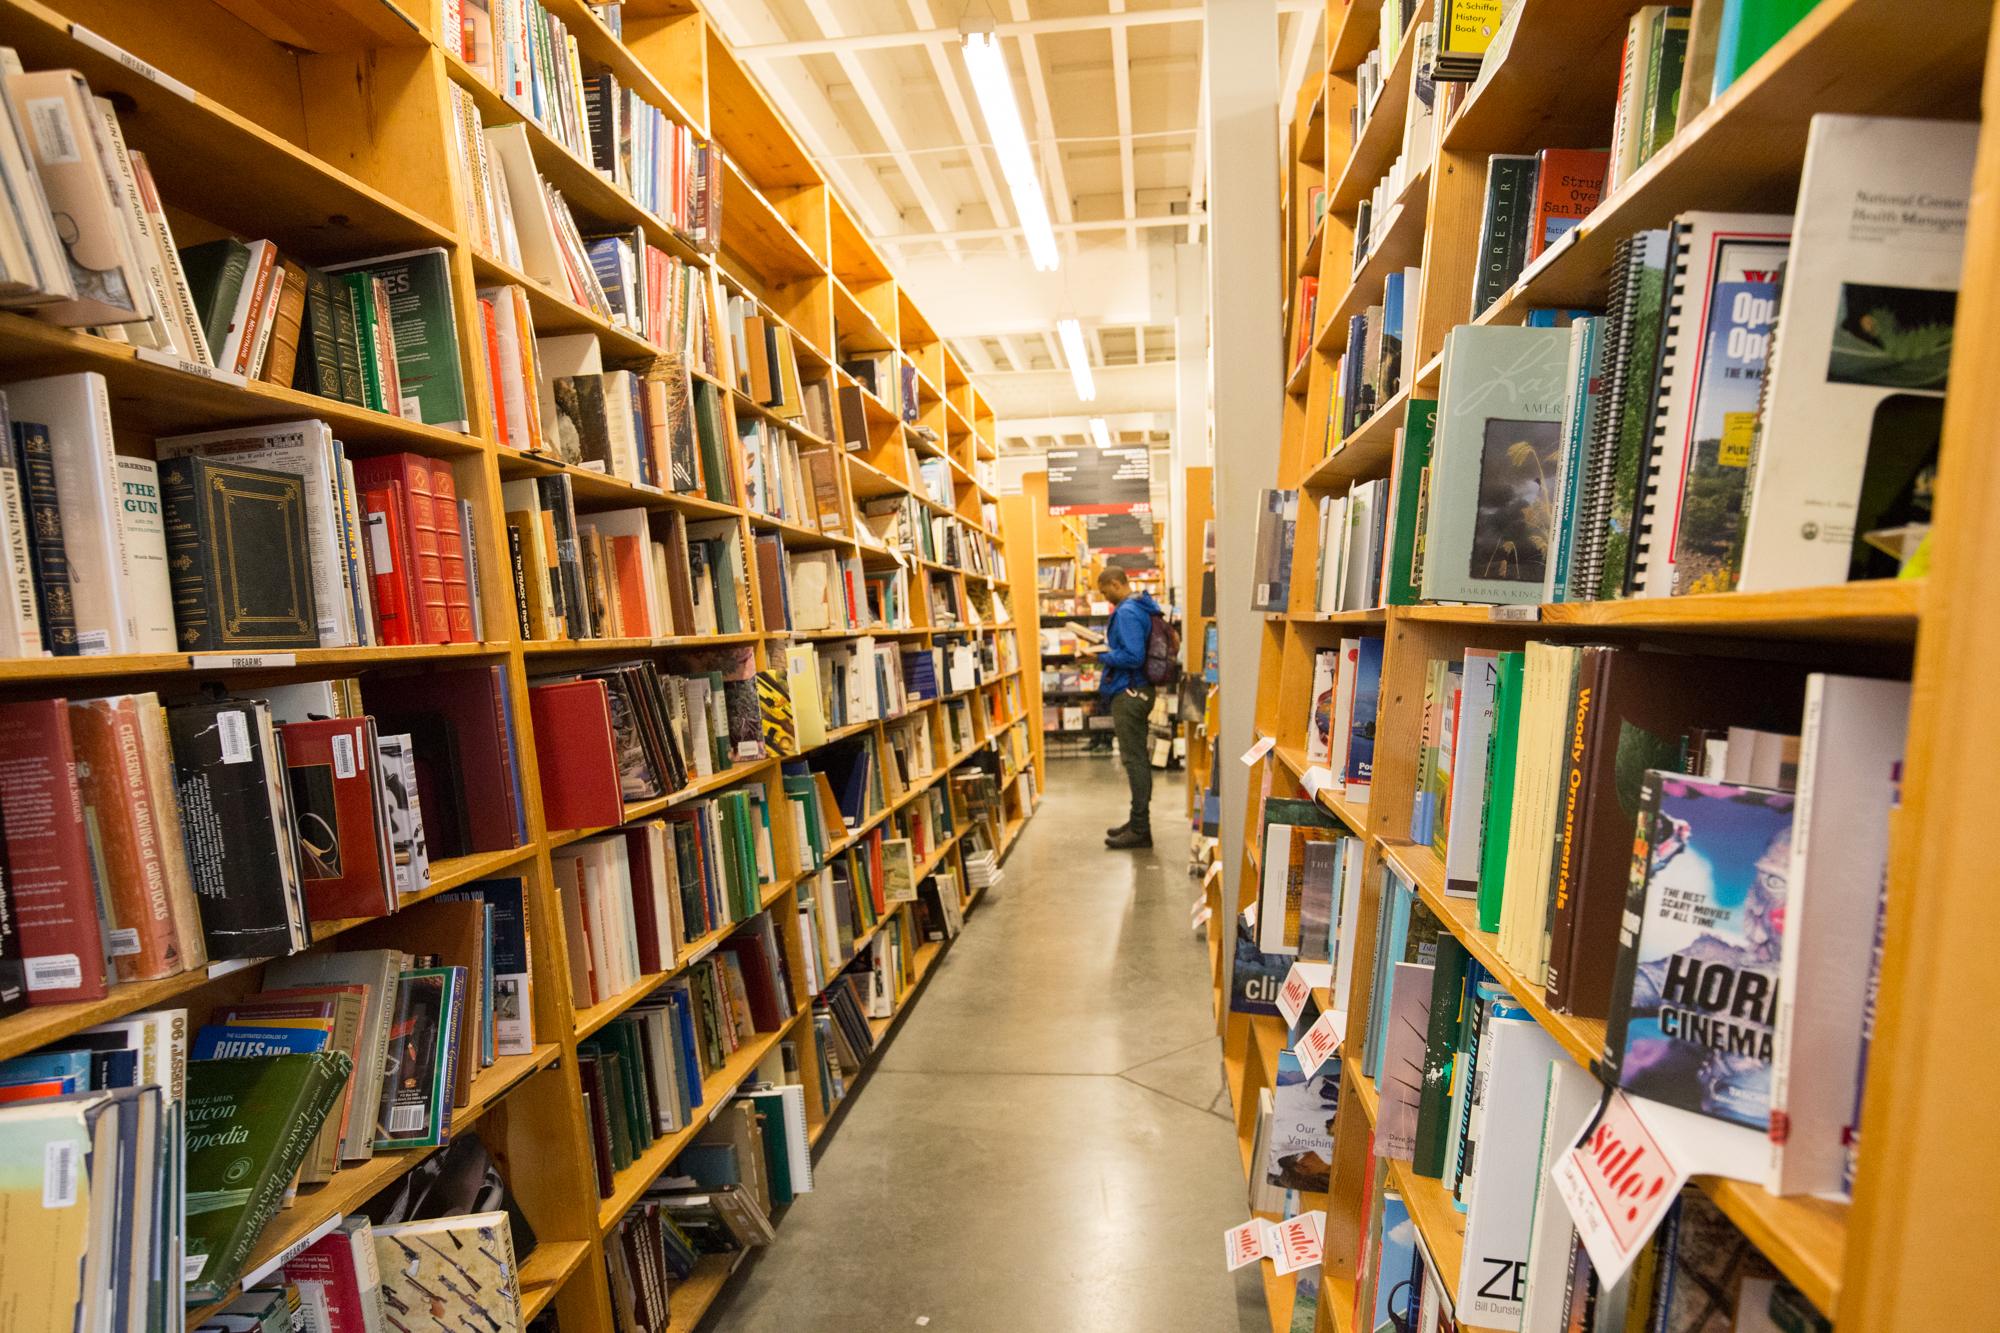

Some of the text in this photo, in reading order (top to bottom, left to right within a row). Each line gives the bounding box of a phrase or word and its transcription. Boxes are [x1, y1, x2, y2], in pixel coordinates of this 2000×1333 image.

[1456, 14, 1486, 23] History
[1466, 3, 1498, 11] Schiffer
[120, 53, 156, 81] FIREARMS
[105, 113, 149, 238] GUN DIGEST TREASURY
[1544, 203, 1569, 213] San
[158, 222, 179, 276] Modern
[150, 267, 161, 287] GUN
[158, 291, 172, 323] DIGEST
[254, 270, 268, 300] THUNDER
[239, 319, 256, 358] MOUNTAINS
[179, 360, 212, 378] FIREARMS
[1573, 376, 1587, 418] Forestry
[118, 461, 153, 473] GREENER
[122, 482, 156, 498] THE
[341, 488, 351, 510] BOOK
[1561, 478, 1574, 520] Century
[124, 499, 158, 515] GUN
[3, 470, 32, 620] HANDGUNNER'S GUIDE
[516, 571, 526, 598] TRACK
[523, 622, 531, 639] CAT
[1460, 587, 1508, 597] BARBARA
[232, 658, 262, 667] FIREARMS
[332, 691, 340, 715] GUNS
[1415, 691, 1434, 793] Wetlands
[66, 761, 82, 824] DOUBLE SHOTGUNS
[1556, 688, 1591, 910] Woody Ornamentals
[119, 723, 142, 788] CHECKERING
[133, 799, 155, 846] CARVING
[146, 862, 168, 920] GUNSTOCKS
[1663, 887, 1706, 901] THE BEST
[1660, 908, 1715, 928] OF ALL TIME
[1661, 898, 1731, 921] SCARY MOVIES
[386, 975, 394, 992] THE
[444, 976, 462, 1104] Fine European Gunmakers
[1309, 1026, 1334, 1058] sale!
[1661, 1006, 1774, 1065] CINEMA
[212, 1041, 291, 1061] RIFLES AND
[375, 1034, 387, 1081] SHOTGUN
[186, 1105, 237, 1122] xicon
[186, 1128, 249, 1152] lopedia
[294, 1107, 327, 1157] Lexicon
[1296, 1123, 1315, 1134] Our
[232, 1110, 308, 1264] Lexicon Encyclopedia
[1587, 1122, 1664, 1223] sale!
[280, 1238, 310, 1264] FIREARMS
[1239, 1228, 1258, 1259] sale!
[1288, 1222, 1319, 1261] sale!
[1474, 1300, 1492, 1313] Bill
